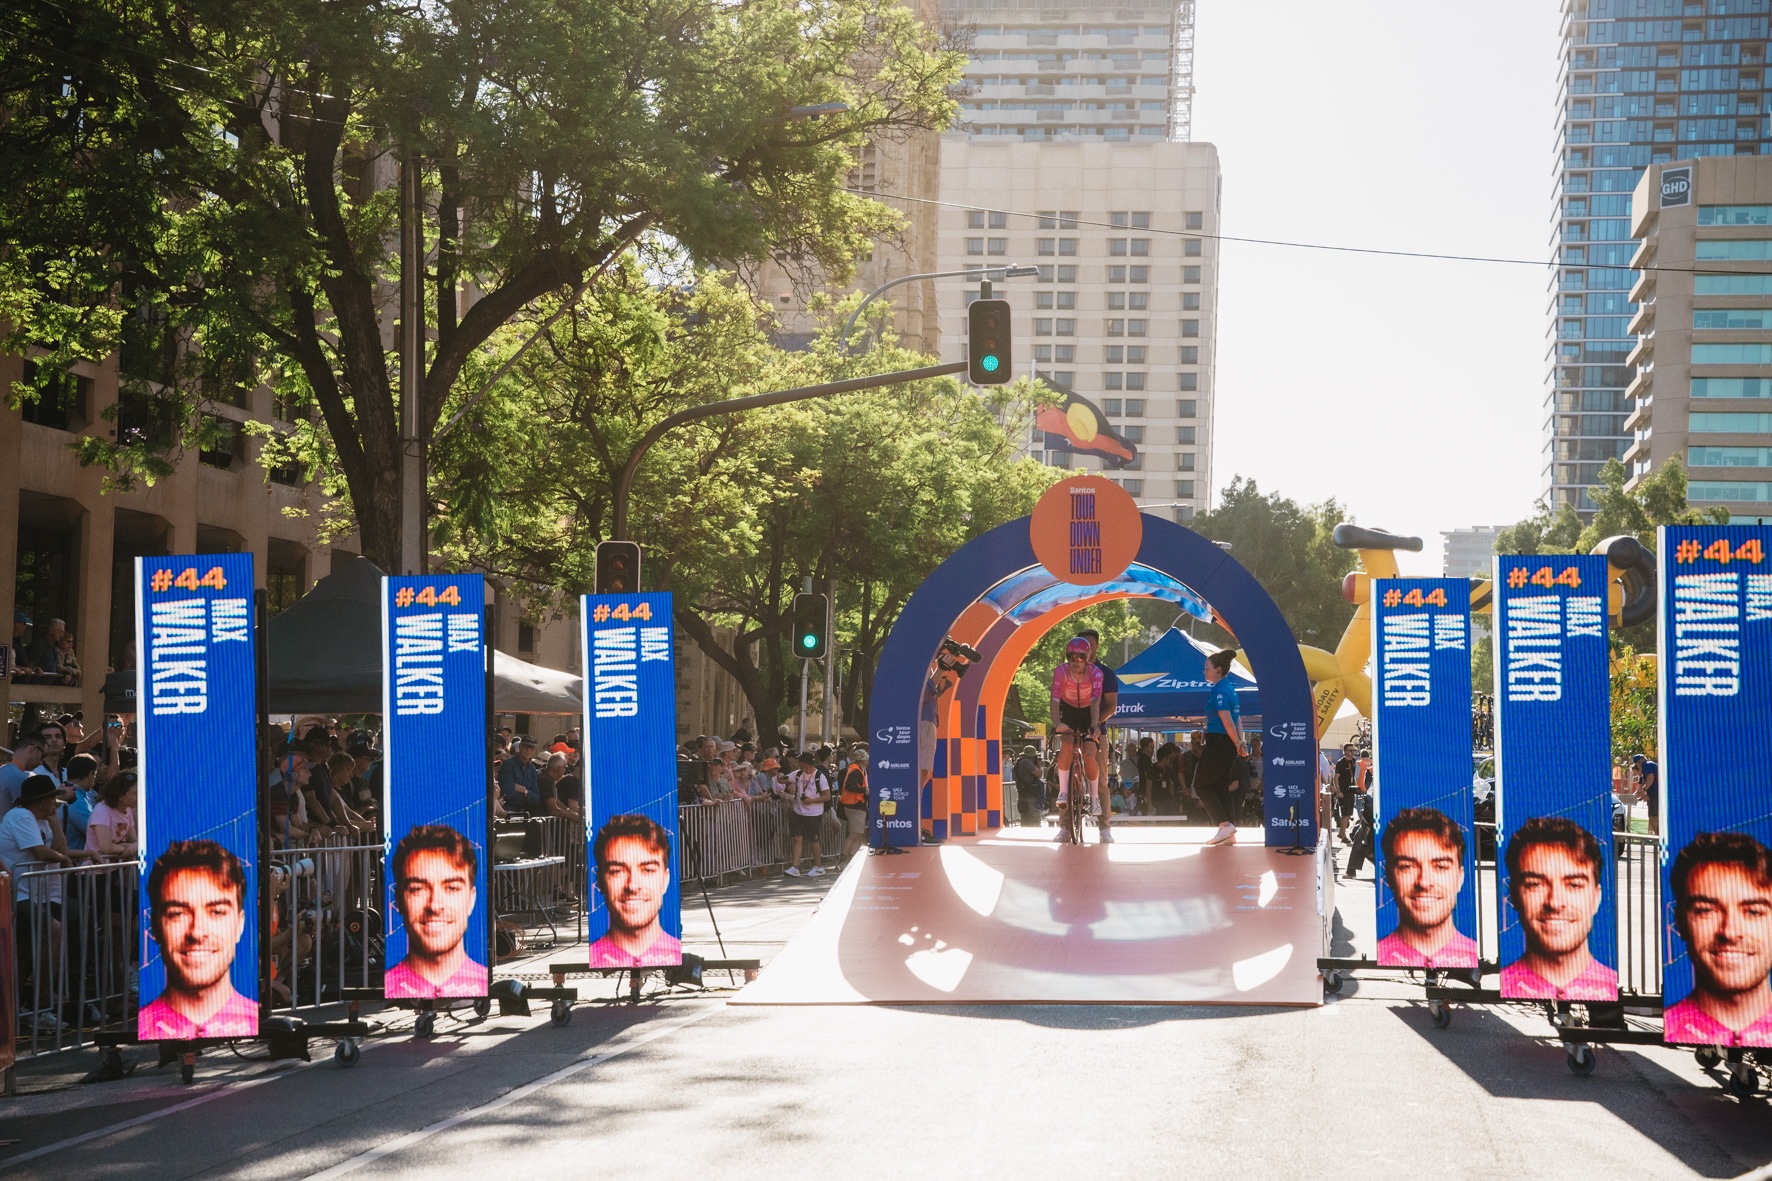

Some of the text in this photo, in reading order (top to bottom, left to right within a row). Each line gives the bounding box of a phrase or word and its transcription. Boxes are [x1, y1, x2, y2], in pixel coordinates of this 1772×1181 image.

[1661, 180, 1688, 195] GHD
[1070, 494, 1096, 520] TOUR
[1069, 521, 1101, 547] DOWN
[1069, 548, 1102, 574] UNDER
[1674, 539, 1765, 565] #44
[150, 566, 228, 592] #44
[1506, 566, 1582, 589] #44
[395, 585, 462, 608] #44
[1383, 588, 1448, 608] #44
[211, 598, 249, 643] MAX
[593, 602, 653, 623] #44
[1566, 596, 1602, 638] MAX
[447, 613, 480, 653] MAX
[640, 627, 670, 662] MAX
[1433, 614, 1466, 650] MAX
[1675, 572, 1740, 697] WALKER
[151, 598, 208, 716] WALKER
[1383, 613, 1431, 707] WALKER
[1507, 595, 1562, 702] WALKER
[396, 613, 444, 716] WALKER
[594, 627, 639, 718] WALKER
[1320, 688, 1340, 715] SAFETY
[876, 819, 912, 829] Sntos
